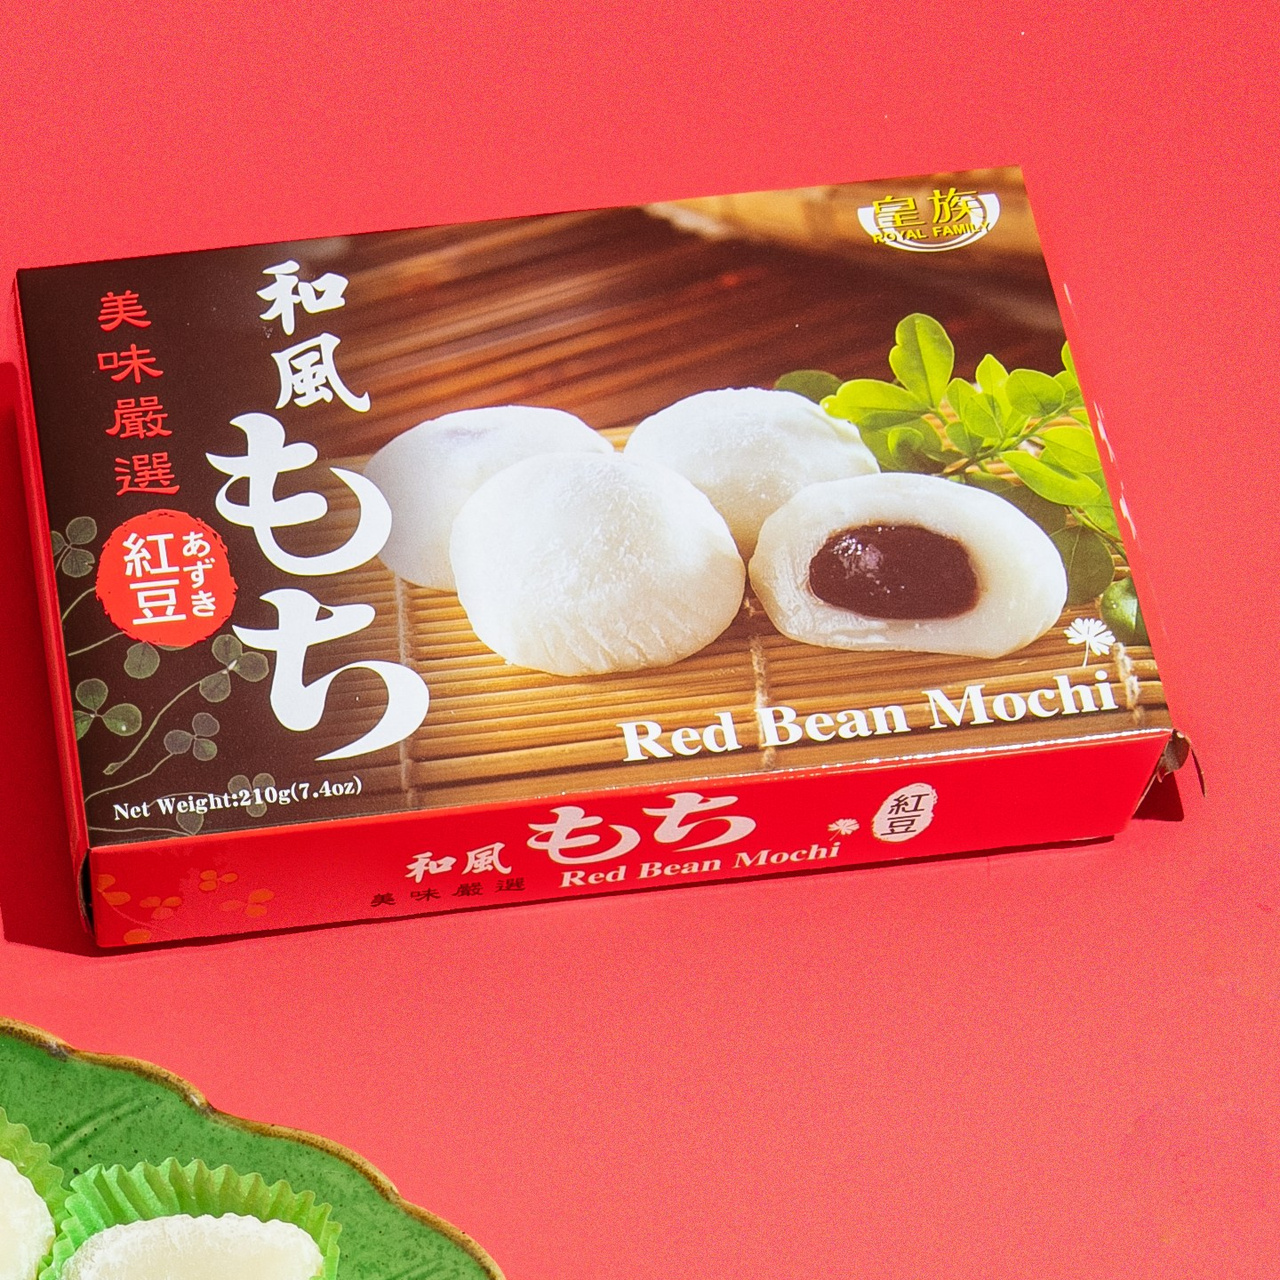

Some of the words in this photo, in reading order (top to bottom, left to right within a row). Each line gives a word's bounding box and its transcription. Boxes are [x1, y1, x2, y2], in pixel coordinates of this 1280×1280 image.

[872, 187, 978, 229] 皇族
[872, 228, 927, 244] ROYAL
[932, 221, 990, 238] FAMILY
[122, 532, 187, 625] 紅豆
[181, 530, 217, 618] あずき
[617, 711, 742, 762] Red
[758, 703, 911, 748] Bean
[921, 670, 1119, 731] Mochi
[113, 801, 150, 821] Net
[880, 793, 930, 836] 紅豆
[560, 866, 625, 888] Red
[637, 858, 721, 880] Bean
[732, 841, 841, 868] Mochi
